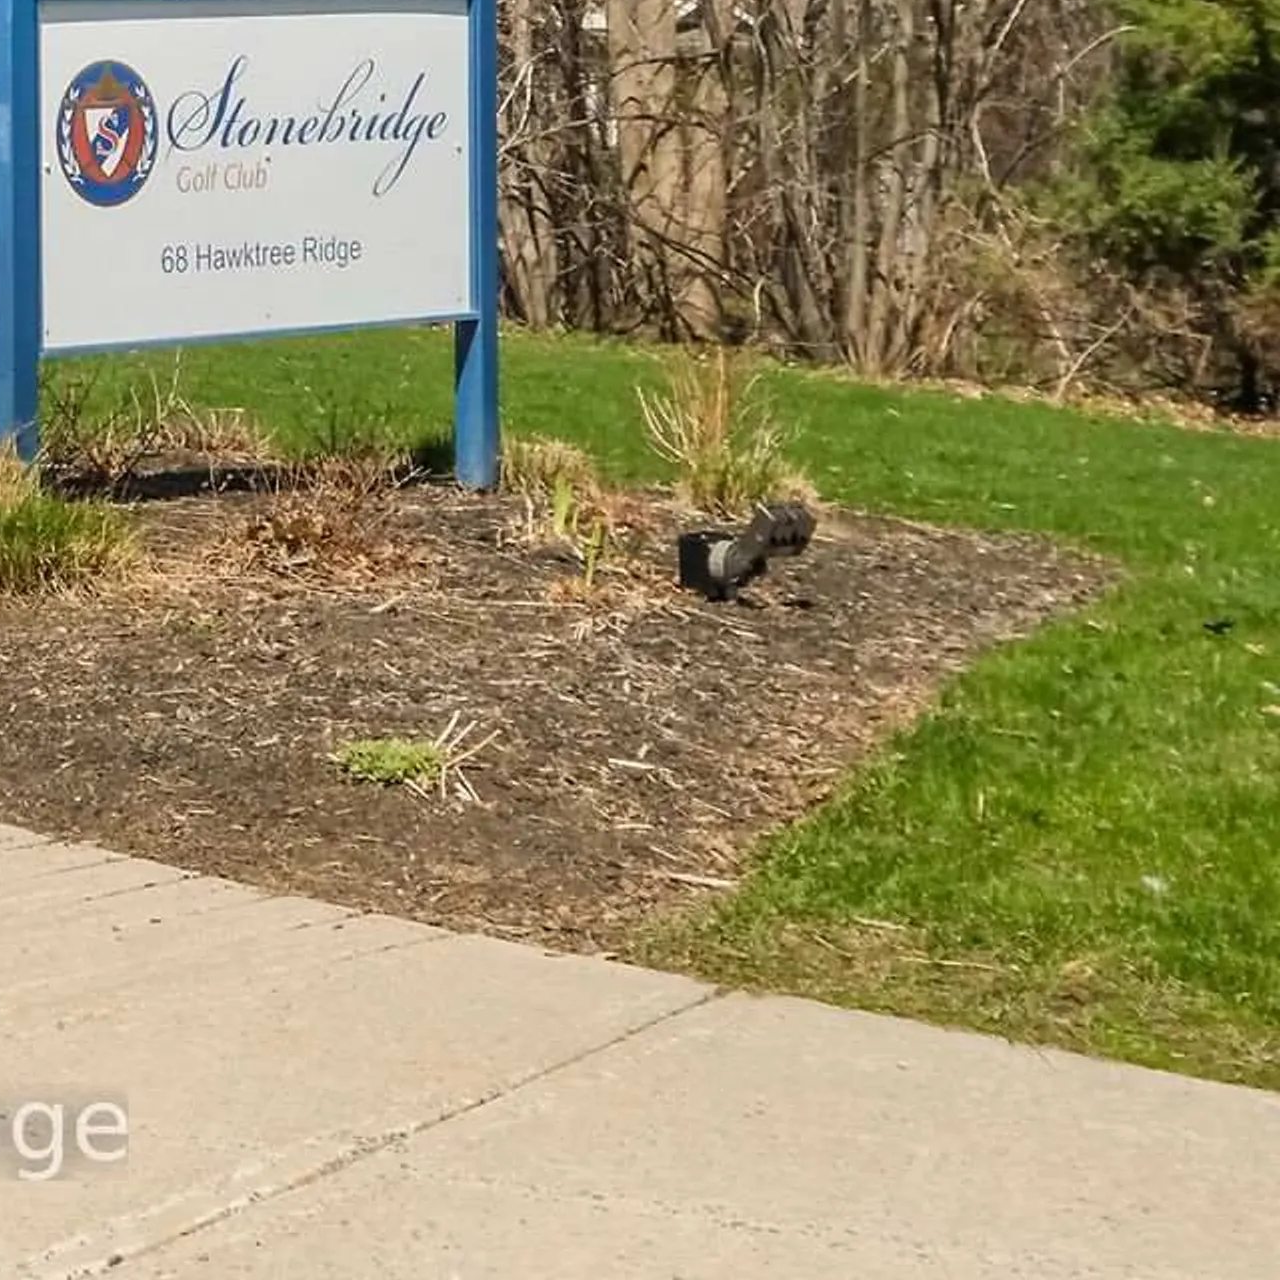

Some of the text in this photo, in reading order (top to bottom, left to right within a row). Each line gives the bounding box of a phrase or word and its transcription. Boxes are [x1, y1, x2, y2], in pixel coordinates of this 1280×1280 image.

[165, 55, 446, 196] Stonebridge
[176, 161, 268, 194] Golf Club
[161, 235, 362, 274] 68 Hawktree Ridge
